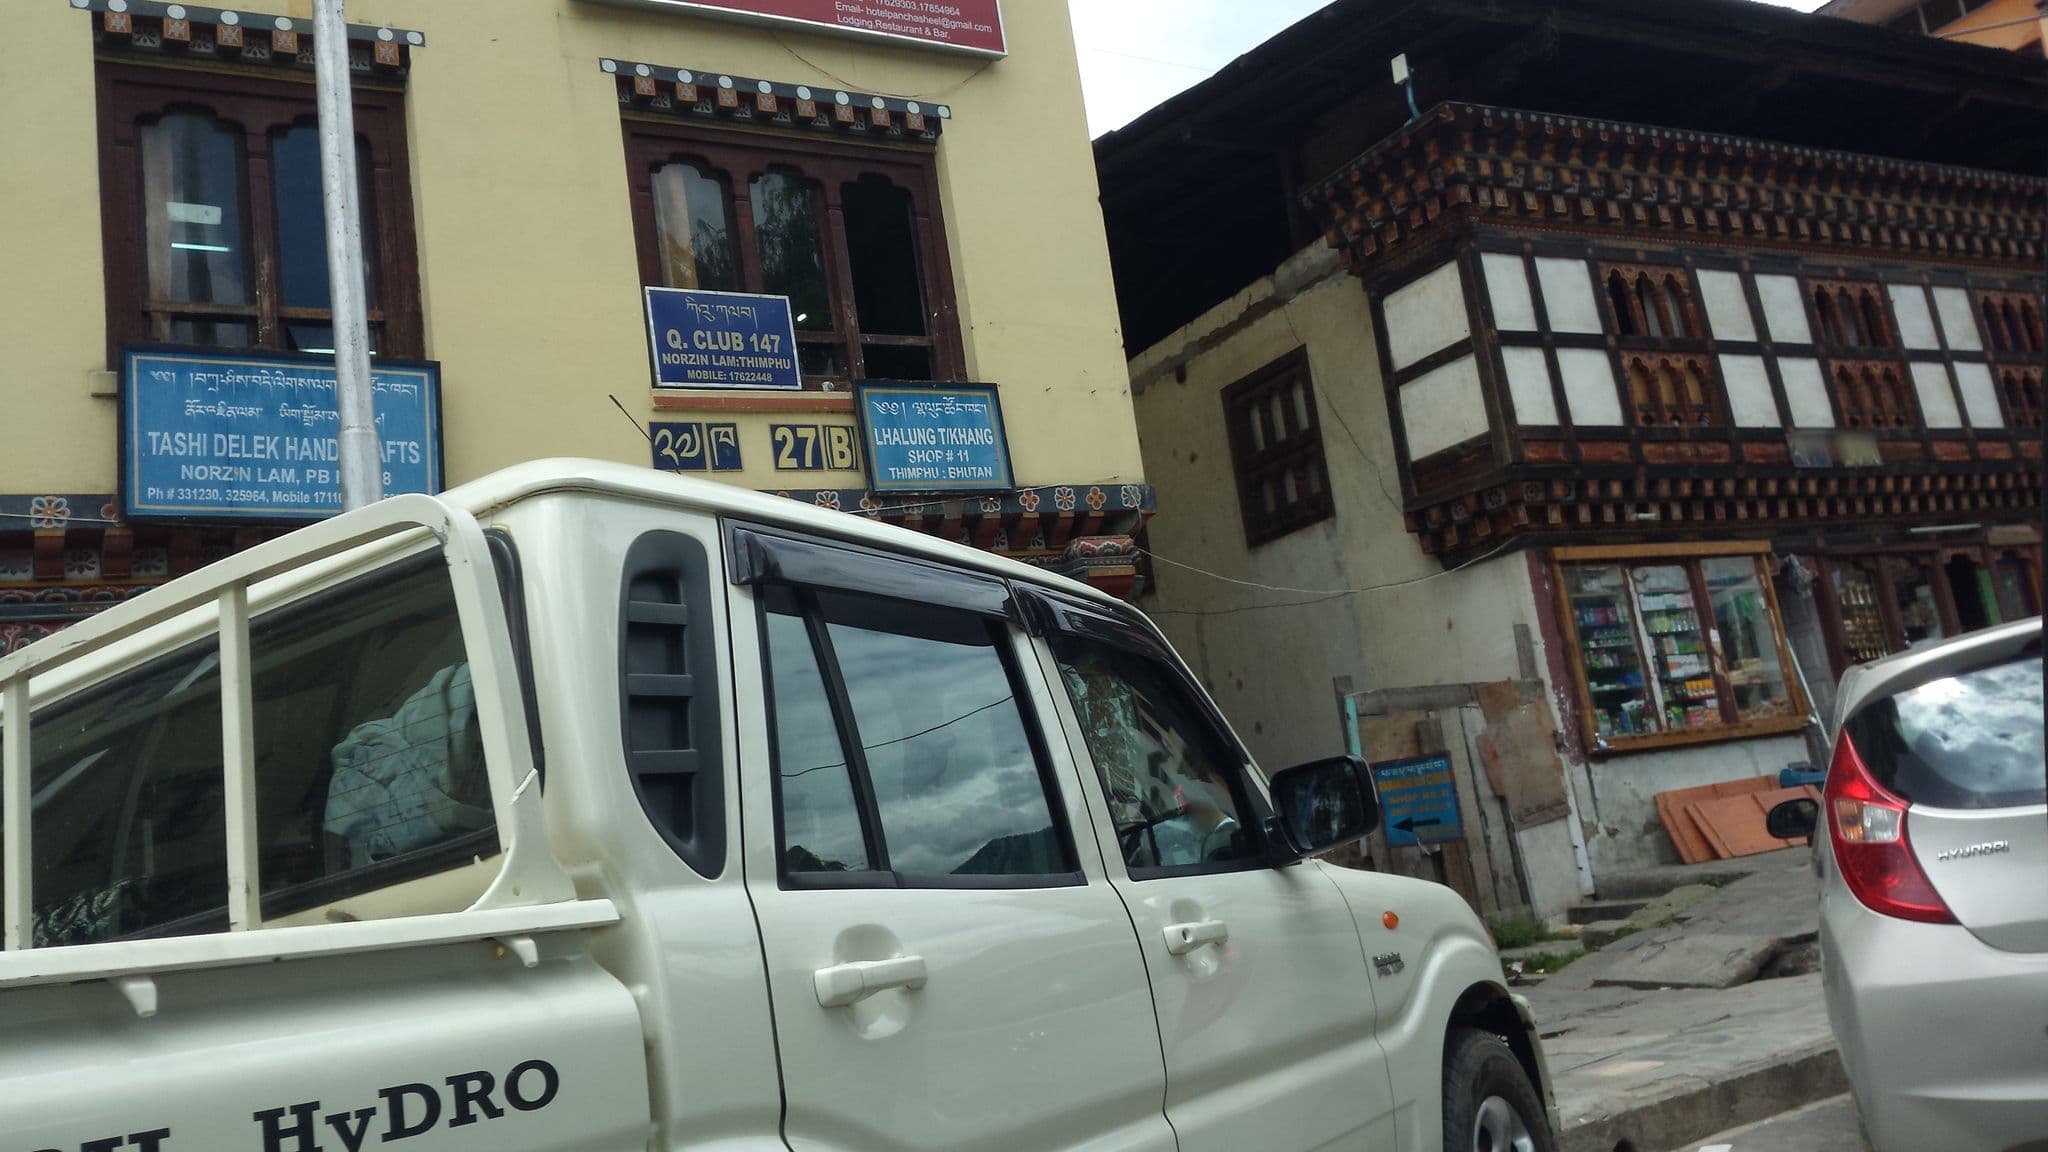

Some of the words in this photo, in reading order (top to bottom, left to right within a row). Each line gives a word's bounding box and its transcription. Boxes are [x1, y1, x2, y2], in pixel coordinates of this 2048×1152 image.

[925, 27, 931, 36] &
[666, 329, 688, 350] Q.
[693, 330, 744, 352] CLUB
[750, 333, 780, 353] 147
[662, 353, 709, 365] NORZIN
[712, 356, 791, 370] LAM:THIMPHU
[687, 369, 727, 381] MOBILE:
[729, 371, 773, 382] 17622448
[874, 427, 936, 446] LHALUNG
[938, 427, 993, 445] TIKHANG
[148, 431, 207, 457] TASHI
[214, 433, 279, 460] DELEK
[775, 427, 816, 468] 27
[908, 450, 943, 463] SHOP
[945, 450, 954, 462] #
[957, 450, 970, 462] 11
[181, 465, 250, 482] NORZIN
[257, 468, 300, 485] LAM,
[306, 469, 330, 484] PB
[889, 467, 939, 480] THIMPHU
[948, 467, 992, 479] BHUTAN
[148, 487, 163, 500] Ph
[167, 488, 174, 500] #
[177, 488, 222, 501] 331230,
[225, 490, 269, 503] 325964,
[273, 490, 310, 503] Mobile
